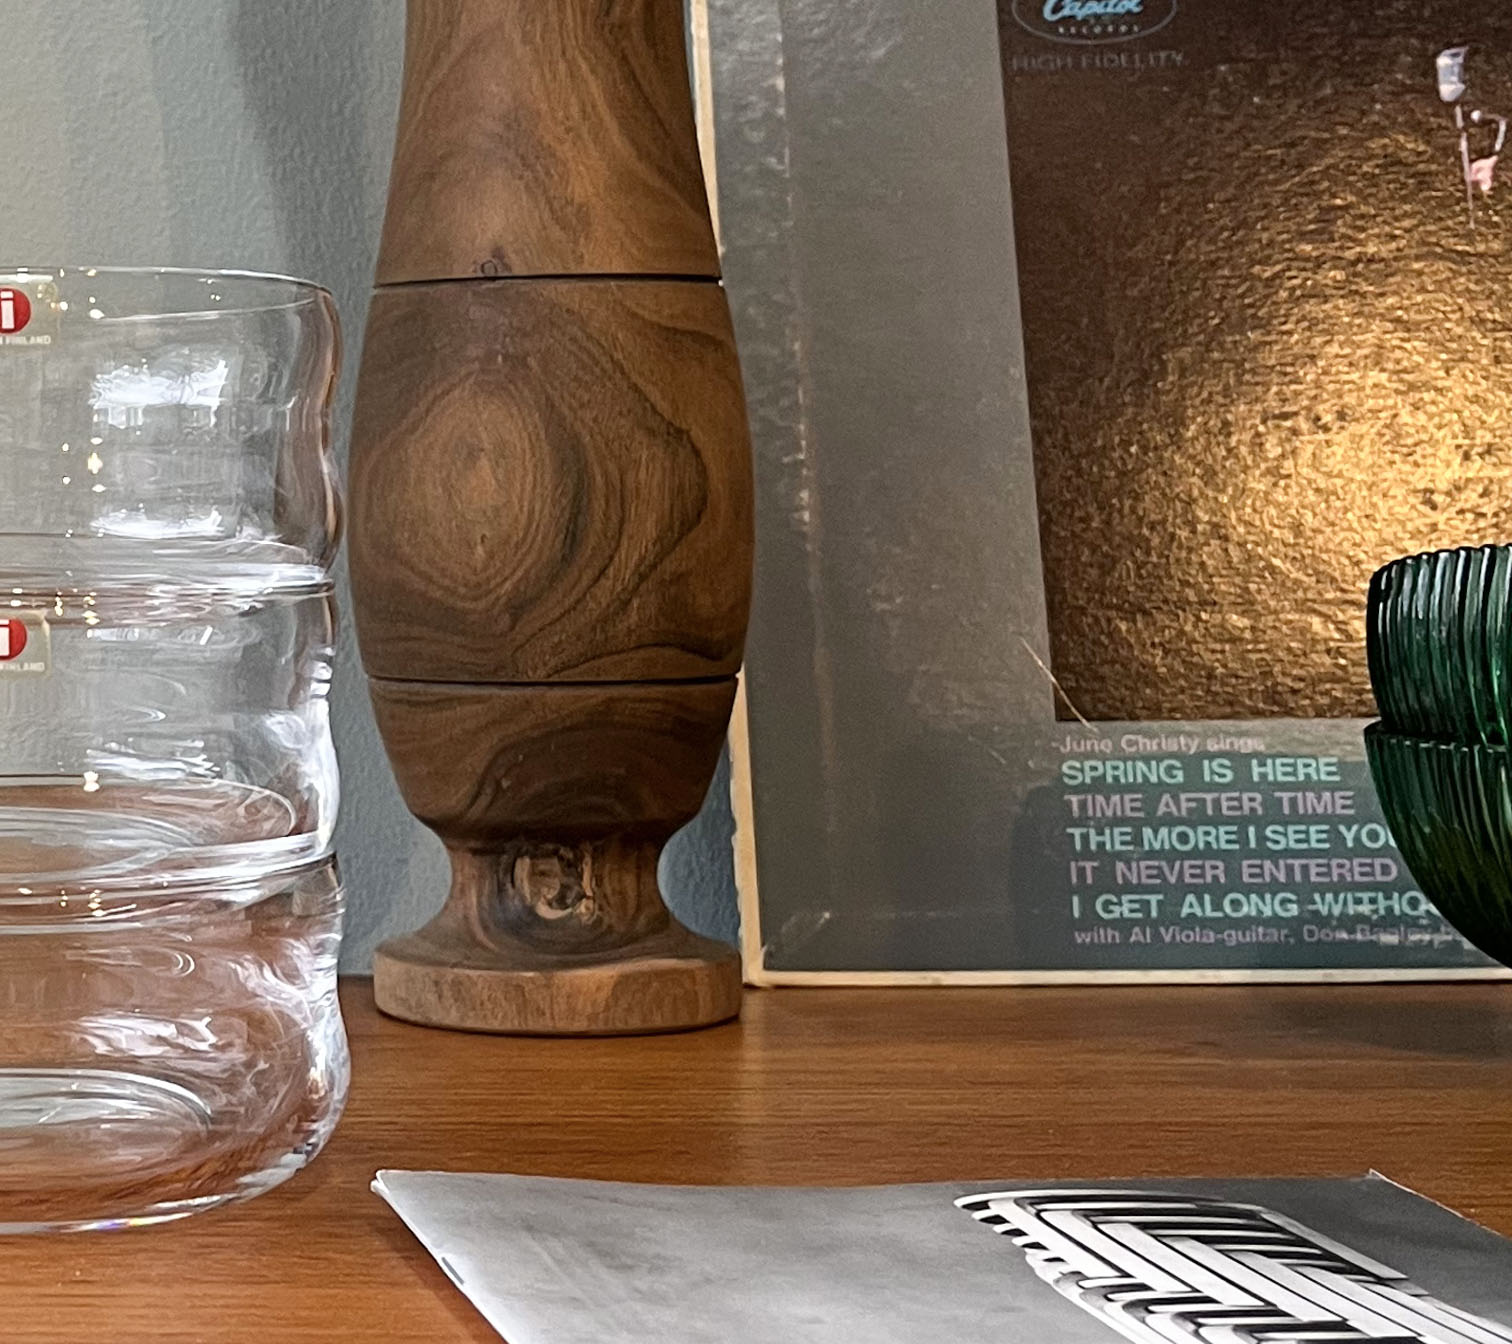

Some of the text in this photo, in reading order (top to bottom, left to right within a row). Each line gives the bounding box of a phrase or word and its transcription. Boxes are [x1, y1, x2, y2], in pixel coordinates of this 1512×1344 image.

[5, 334, 52, 346] FINLAND
[1120, 733, 1200, 755] Christy
[1061, 756, 1342, 786] SPRING IS HERE
[1063, 790, 1357, 818] TIME AFTER TIME
[1065, 826, 1134, 851] THE
[1141, 824, 1240, 851] MORE
[1246, 824, 1257, 849] I
[1264, 823, 1331, 851] SEE
[1069, 857, 1399, 885] IT NEVER ENTERED
[1071, 889, 1442, 920] I GET ALONG WITHO
[1074, 925, 1121, 945] with
[1129, 925, 1152, 944] Al
[1302, 924, 1350, 943] Don
